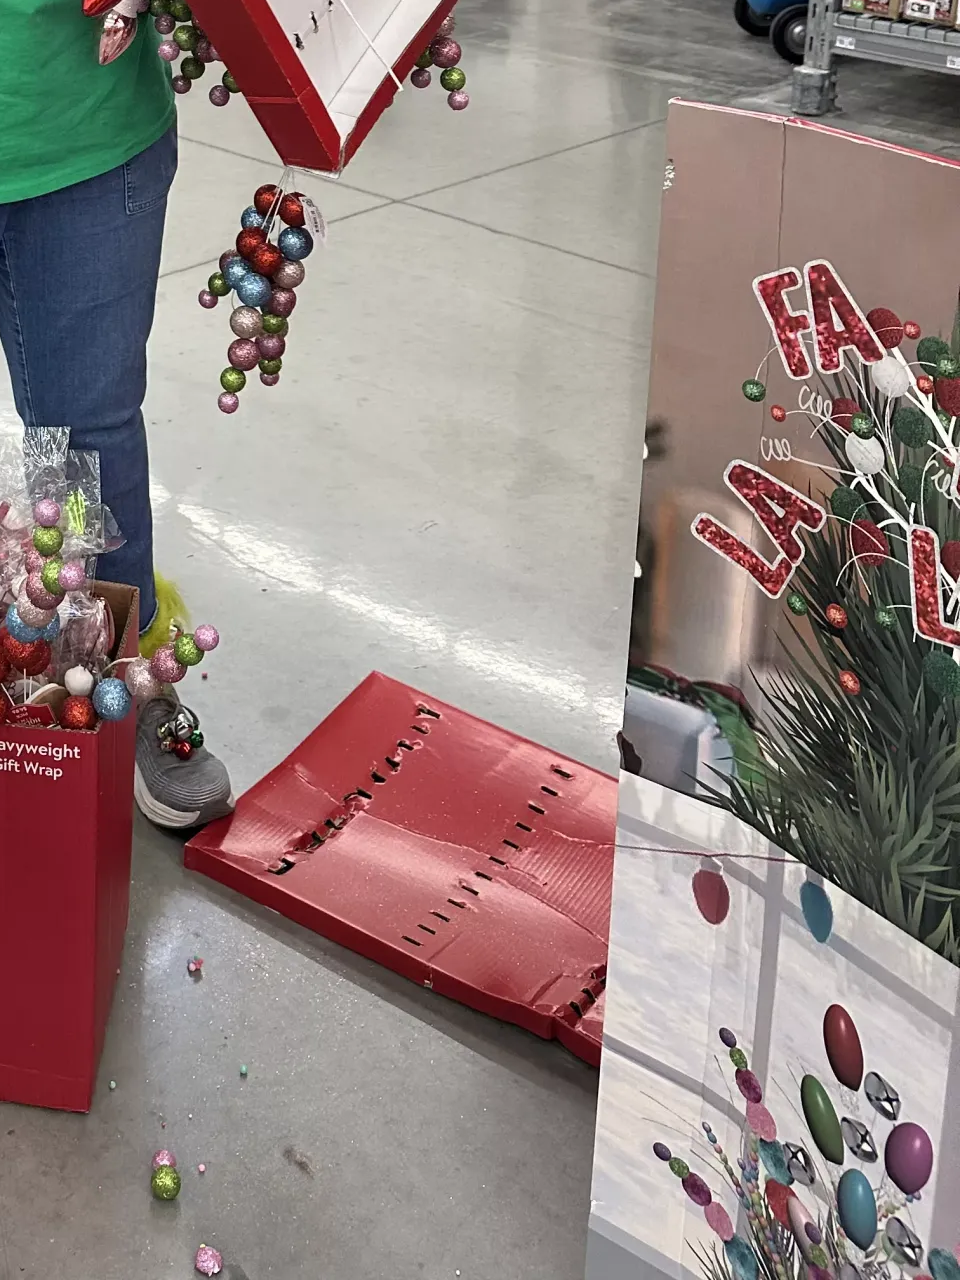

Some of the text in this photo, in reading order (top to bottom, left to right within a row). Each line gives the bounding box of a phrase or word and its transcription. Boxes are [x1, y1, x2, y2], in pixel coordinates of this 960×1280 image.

[752, 258, 887, 380] FA
[690, 458, 827, 600] LA
[24, 761, 63, 781] Wrap
